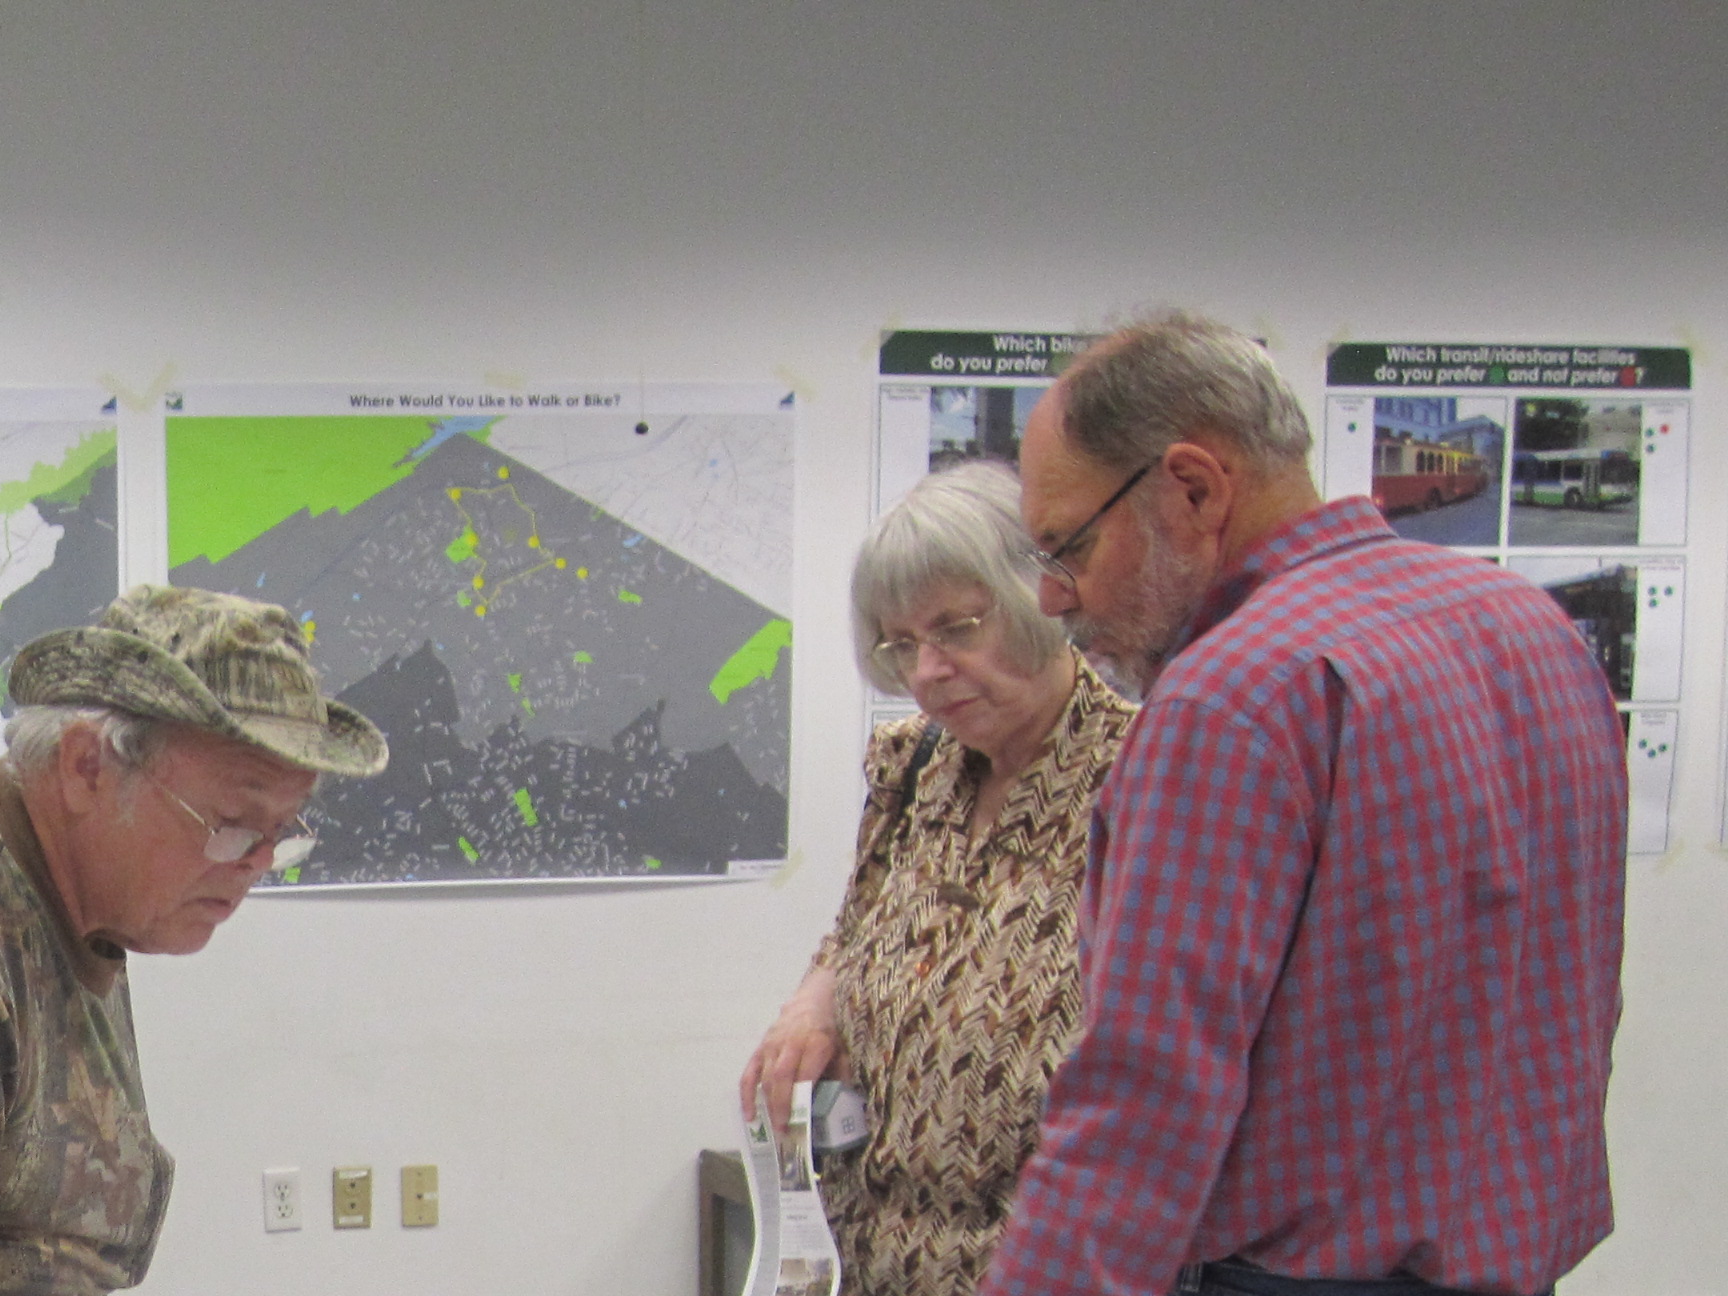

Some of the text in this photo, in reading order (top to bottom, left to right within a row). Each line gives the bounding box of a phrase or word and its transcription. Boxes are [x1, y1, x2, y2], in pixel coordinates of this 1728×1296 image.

[993, 335, 1046, 352] Which
[930, 353, 1048, 374] do you prefer
[1386, 347, 1436, 364] Which
[1573, 349, 1636, 365] facilities
[1374, 366, 1396, 381] do
[1402, 369, 1432, 384] you
[1436, 367, 1486, 384] prefer
[1507, 367, 1539, 382] and
[1543, 367, 1568, 382] not
[1571, 368, 1618, 385] prefer
[349, 394, 621, 408] Where Would You Like to Walk or Bike?
